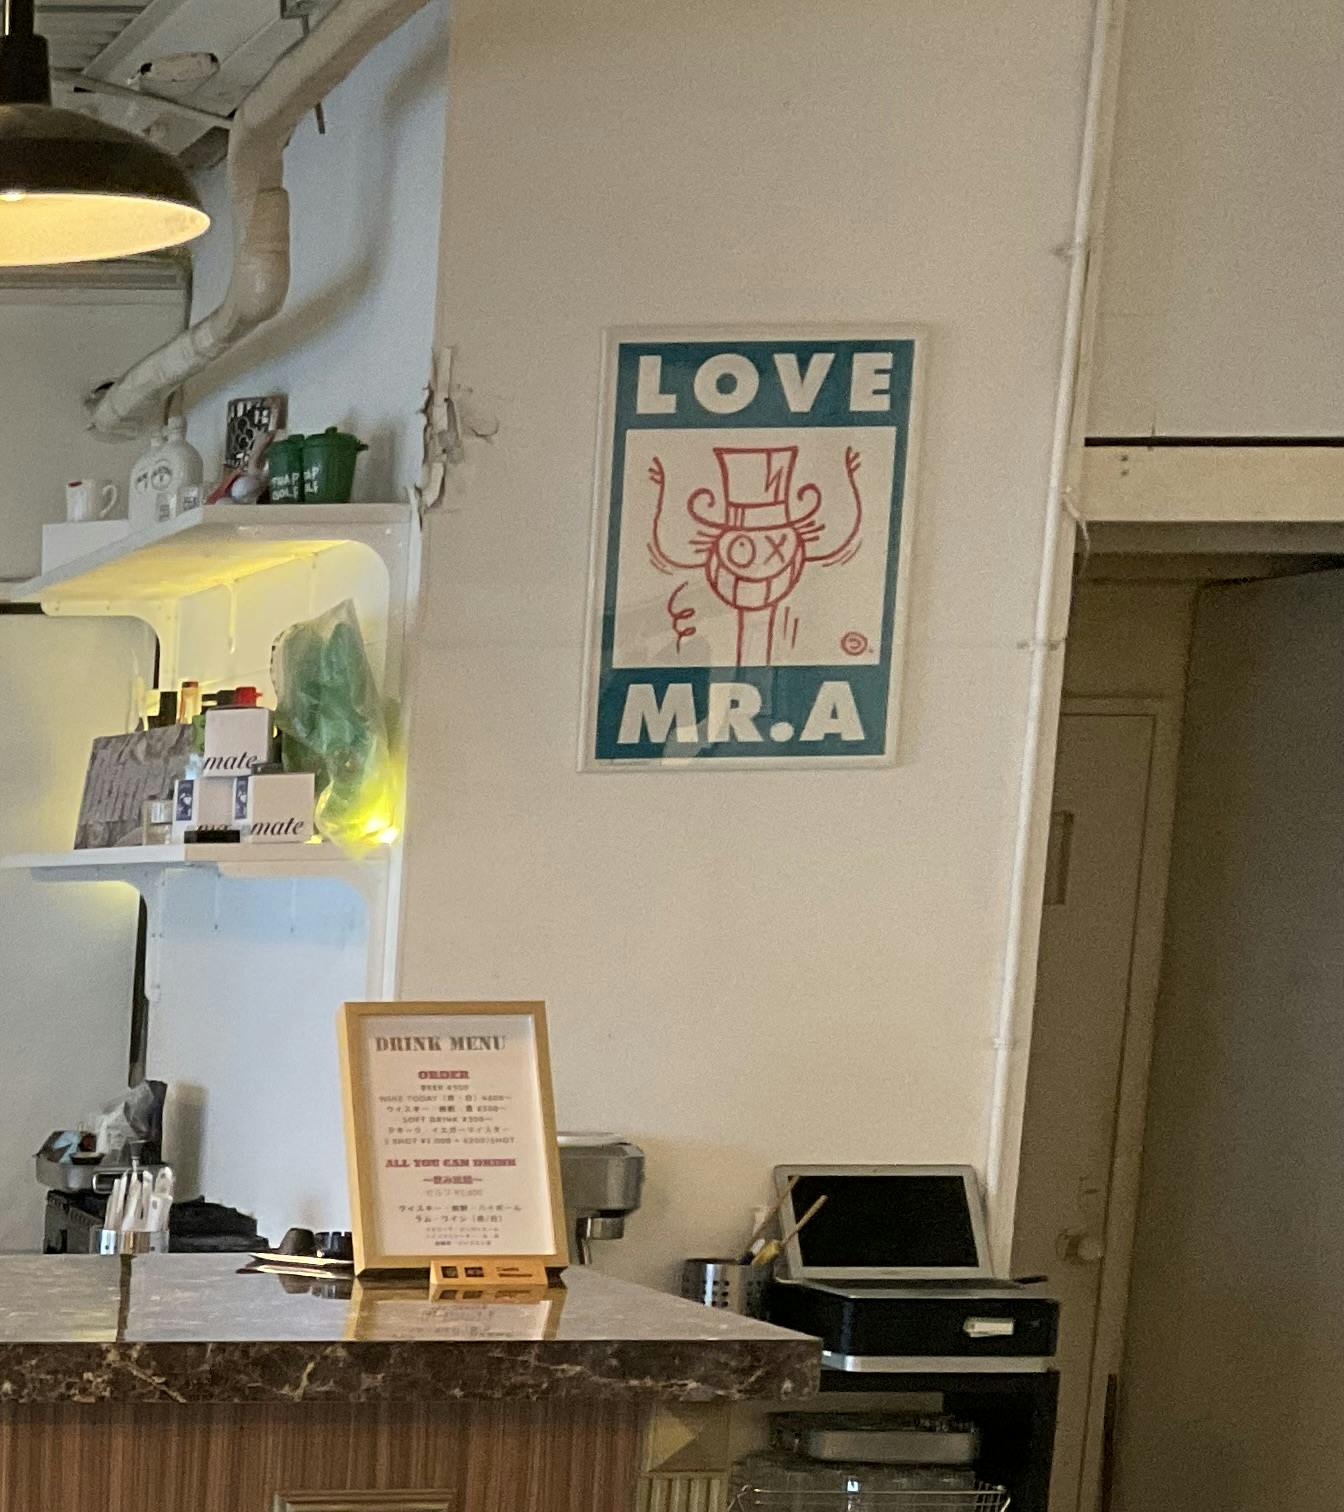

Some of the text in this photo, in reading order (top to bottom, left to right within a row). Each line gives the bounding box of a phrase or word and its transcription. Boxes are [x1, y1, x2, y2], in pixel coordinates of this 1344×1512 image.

[636, 351, 894, 415] LOVE
[617, 681, 865, 744] MR.A
[250, 817, 305, 836] mate
[375, 1035, 507, 1051] DRINK MENU
[418, 1070, 470, 1080] ORDER
[385, 1159, 410, 1168] ALL
[413, 1159, 440, 1167] YOU
[443, 1159, 470, 1167] CAN
